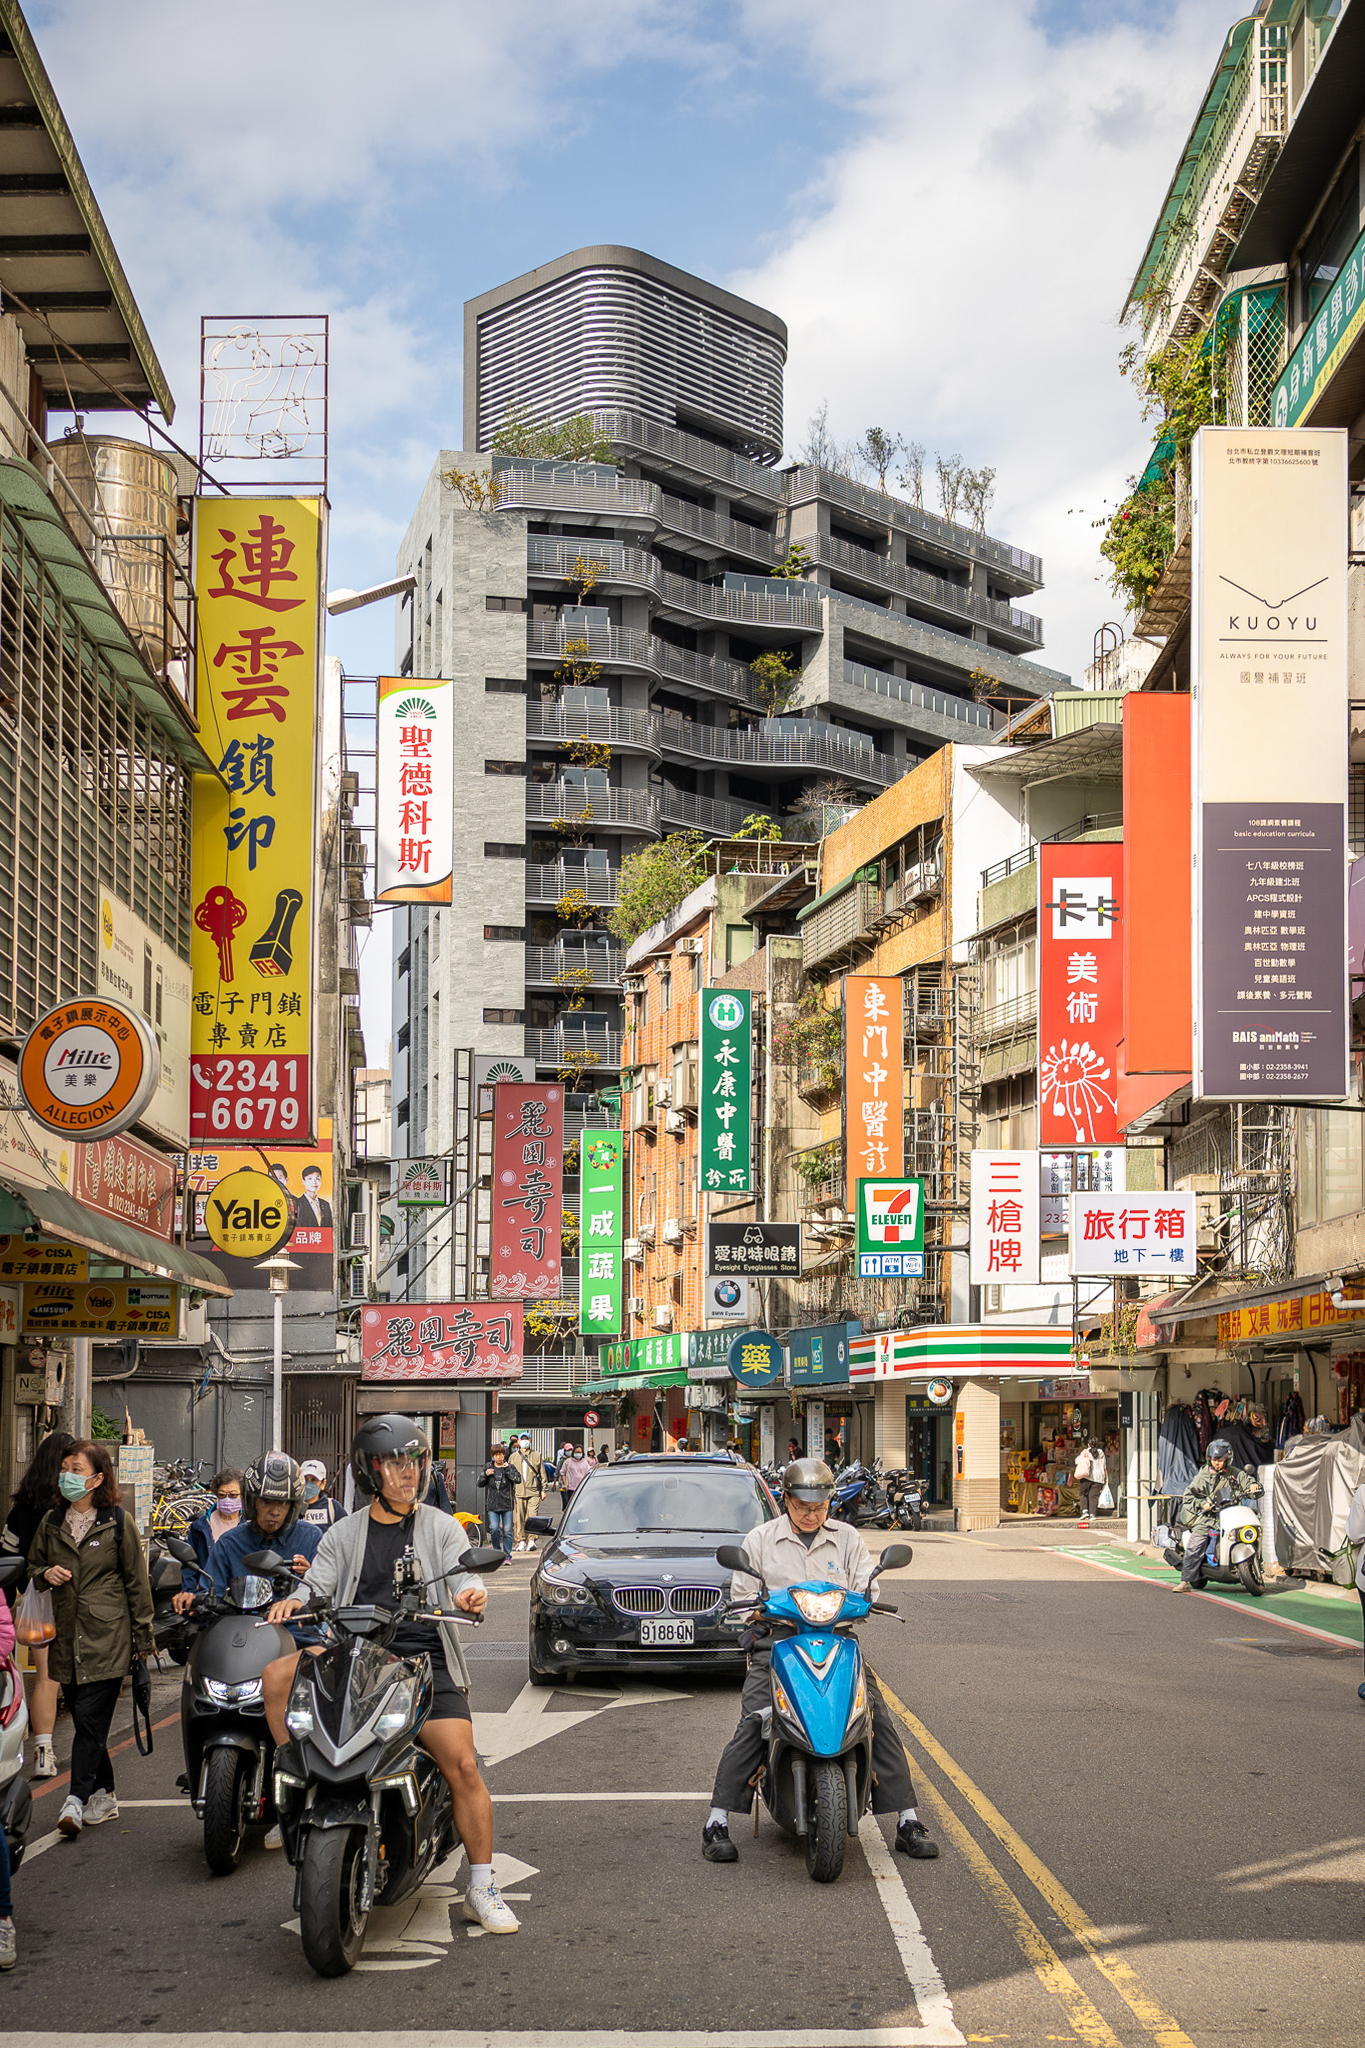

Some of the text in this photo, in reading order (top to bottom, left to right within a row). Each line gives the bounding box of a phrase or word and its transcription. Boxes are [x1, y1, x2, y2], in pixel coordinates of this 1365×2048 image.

[1289, 244, 1365, 411] 身新醫學診
[1229, 616, 1317, 631] KUOYU
[1239, 671, 1307, 685] 國譽補習班
[207, 514, 306, 871] 連雲鎖印
[397, 724, 433, 874] 聖德科斯
[1250, 878, 1300, 886] 九年級建北班
[1246, 894, 1303, 902] APCS程式設計
[1244, 926, 1306, 935] 奧林匹亞 數學班
[1244, 942, 1306, 951] 奧林匹亞 物理班
[1066, 951, 1098, 1024] 美術
[1254, 974, 1296, 983] 兒童美語班
[192, 991, 302, 1016] 電子門鎖
[39, 1008, 130, 1041] 電子鎖展示中心
[207, 1022, 288, 1049] 專賣店
[1232, 1031, 1258, 1043] BAIS
[1259, 1031, 1299, 1043] aniMath
[216, 1059, 299, 1093] 2341
[712, 1038, 740, 1161] 永康中醫
[43, 1100, 115, 1124] ALLEGION
[705, 1168, 747, 1189] 診所
[212, 1199, 282, 1230] Yale
[987, 1162, 1024, 1274] 三槍牌
[1083, 1208, 1186, 1240] 旅行箱
[295, 1231, 322, 1244] 品牌
[45, 1249, 73, 1258] CISA
[588, 1184, 615, 1321] 一成蔬果
[714, 1245, 797, 1263] 愛視特眼鏡
[1113, 1248, 1185, 1263] 地下一樓
[1, 1261, 79, 1276] 電子鎖專賣店
[714, 1264, 741, 1273] Eyesight
[743, 1264, 778, 1273] Eyeglasses
[88, 1296, 113, 1308] Yale
[145, 1311, 171, 1320] CISA
[1248, 1304, 1270, 1336] 文具
[1277, 1298, 1301, 1330] 玩具
[106, 1321, 170, 1332] 電子鎖專賣店
[636, 1336, 674, 1366] 一成蔬果
[741, 1343, 771, 1375] 藥
